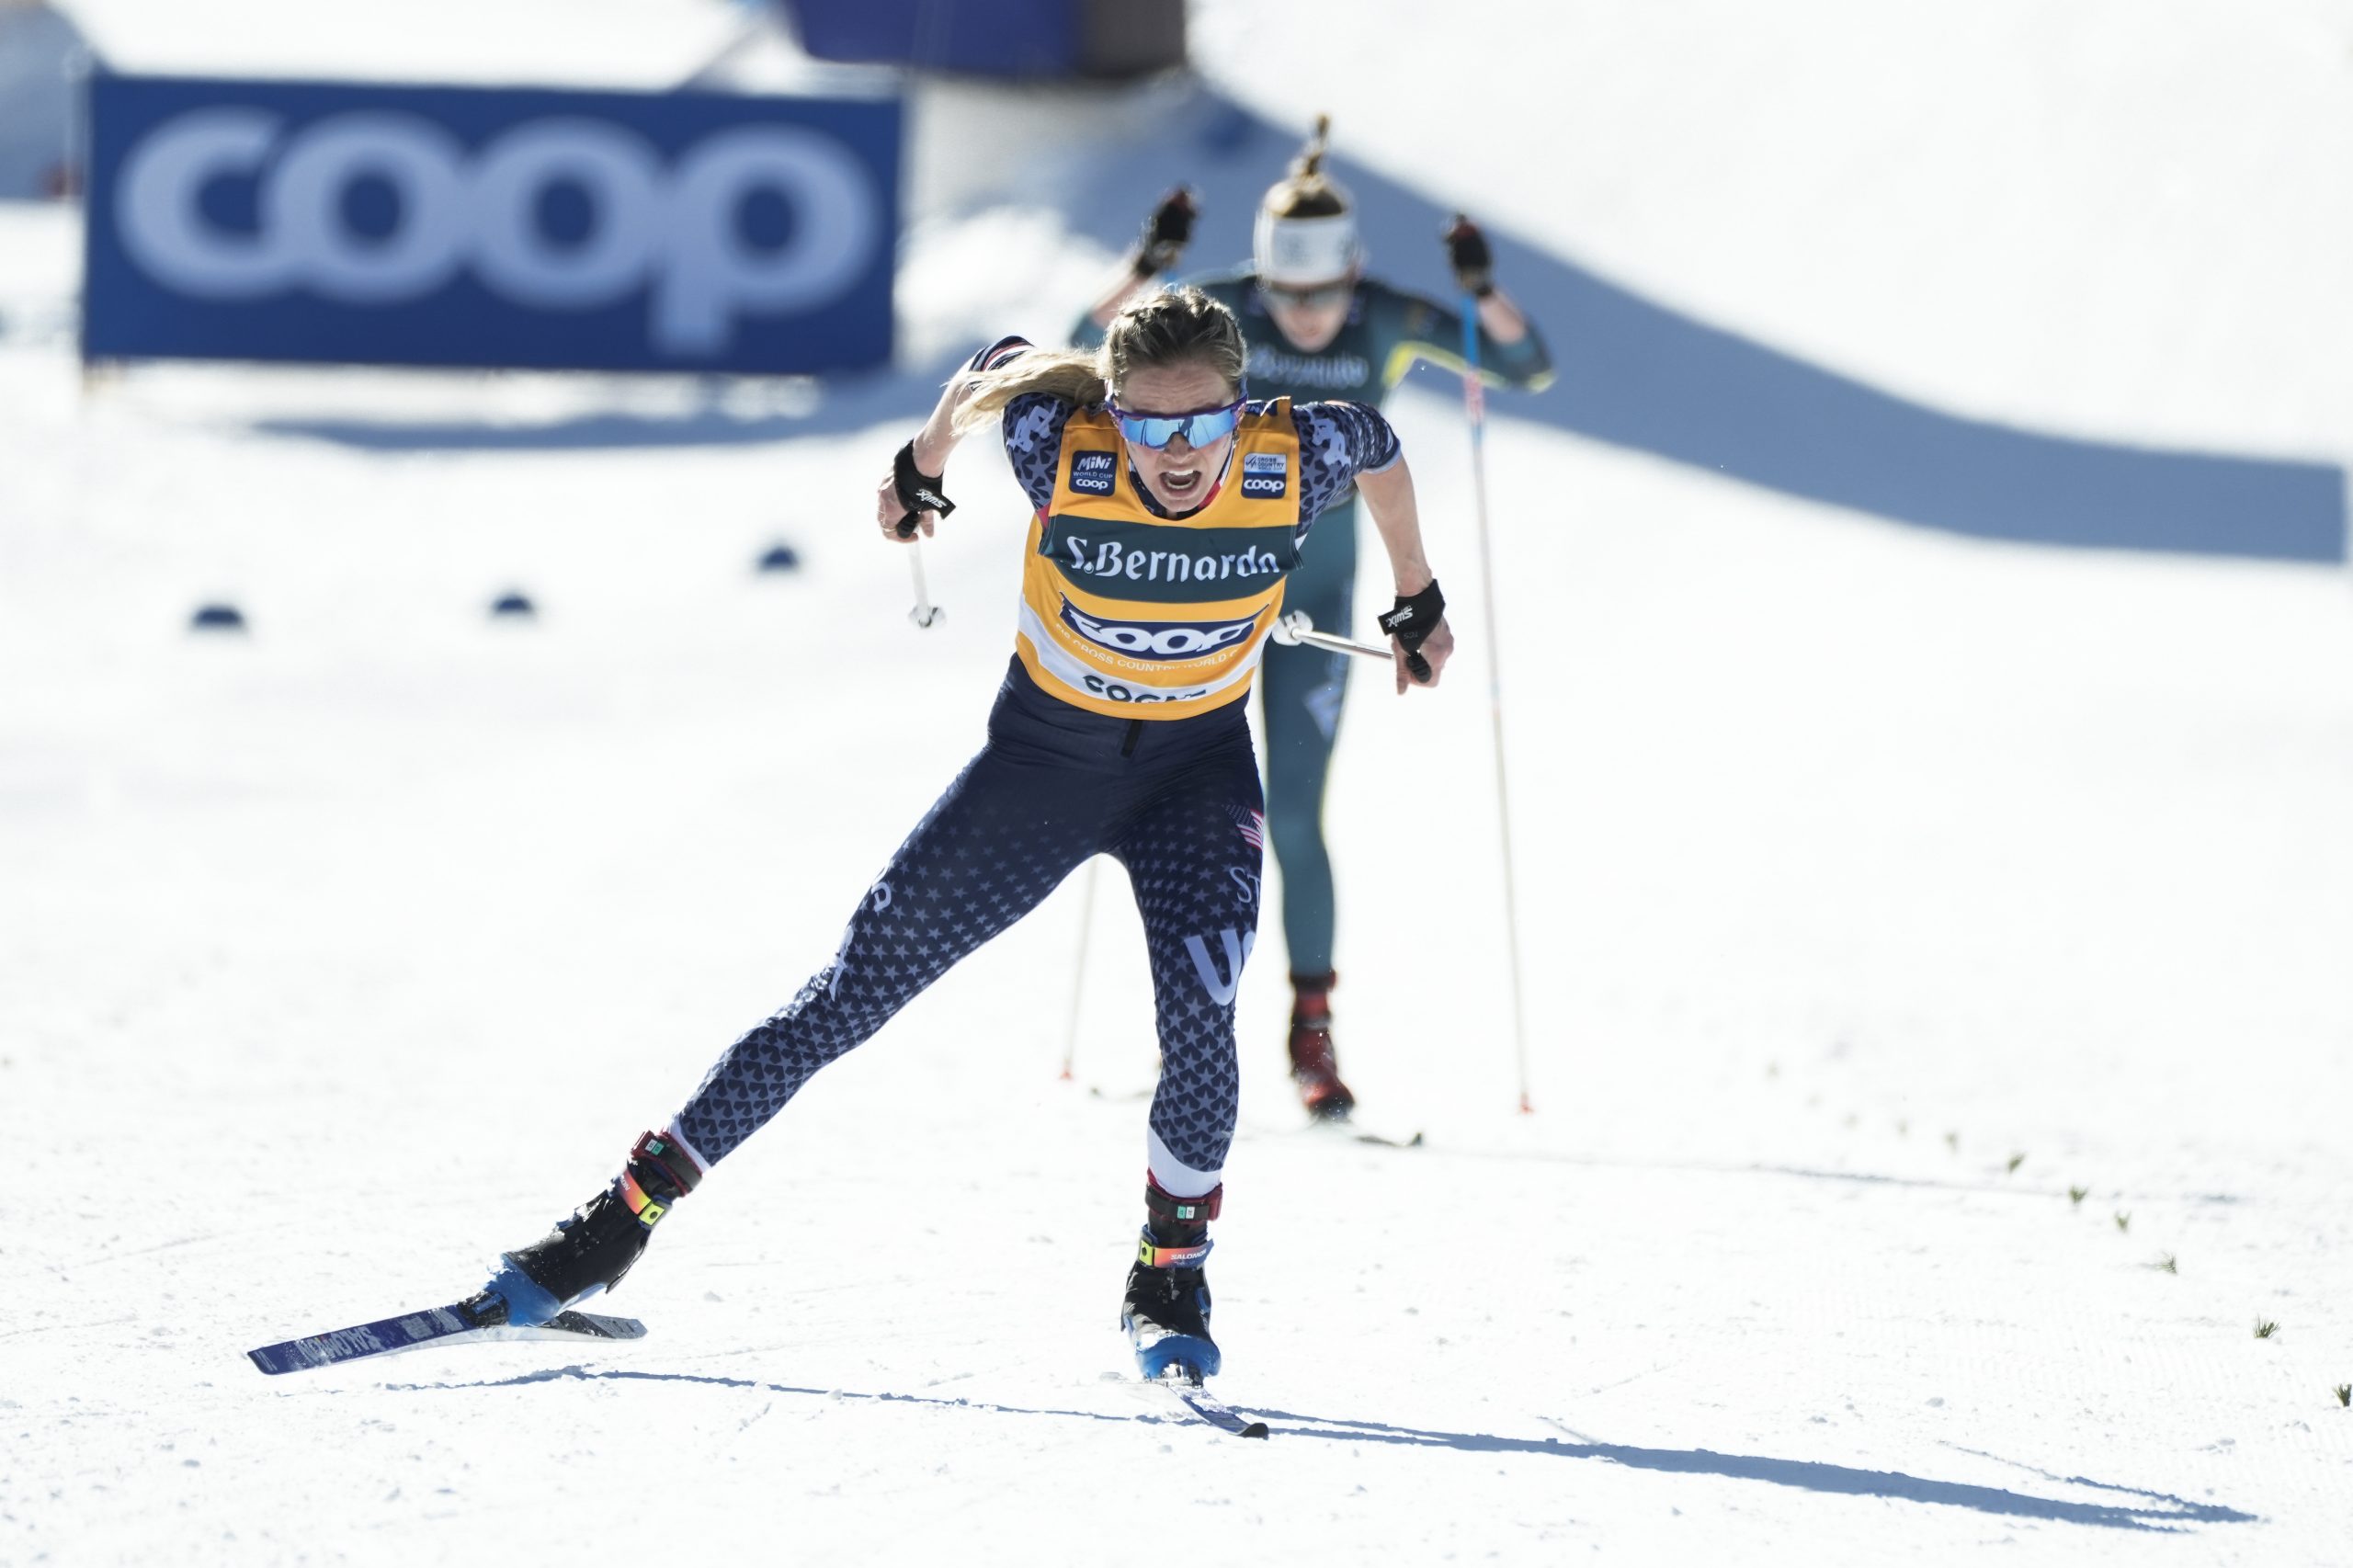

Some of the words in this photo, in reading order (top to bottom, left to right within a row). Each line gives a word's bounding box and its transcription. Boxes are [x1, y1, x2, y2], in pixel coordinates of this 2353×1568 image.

[114, 108, 881, 353] coop
[1075, 478, 1108, 490] coop
[1244, 479, 1285, 493] coop
